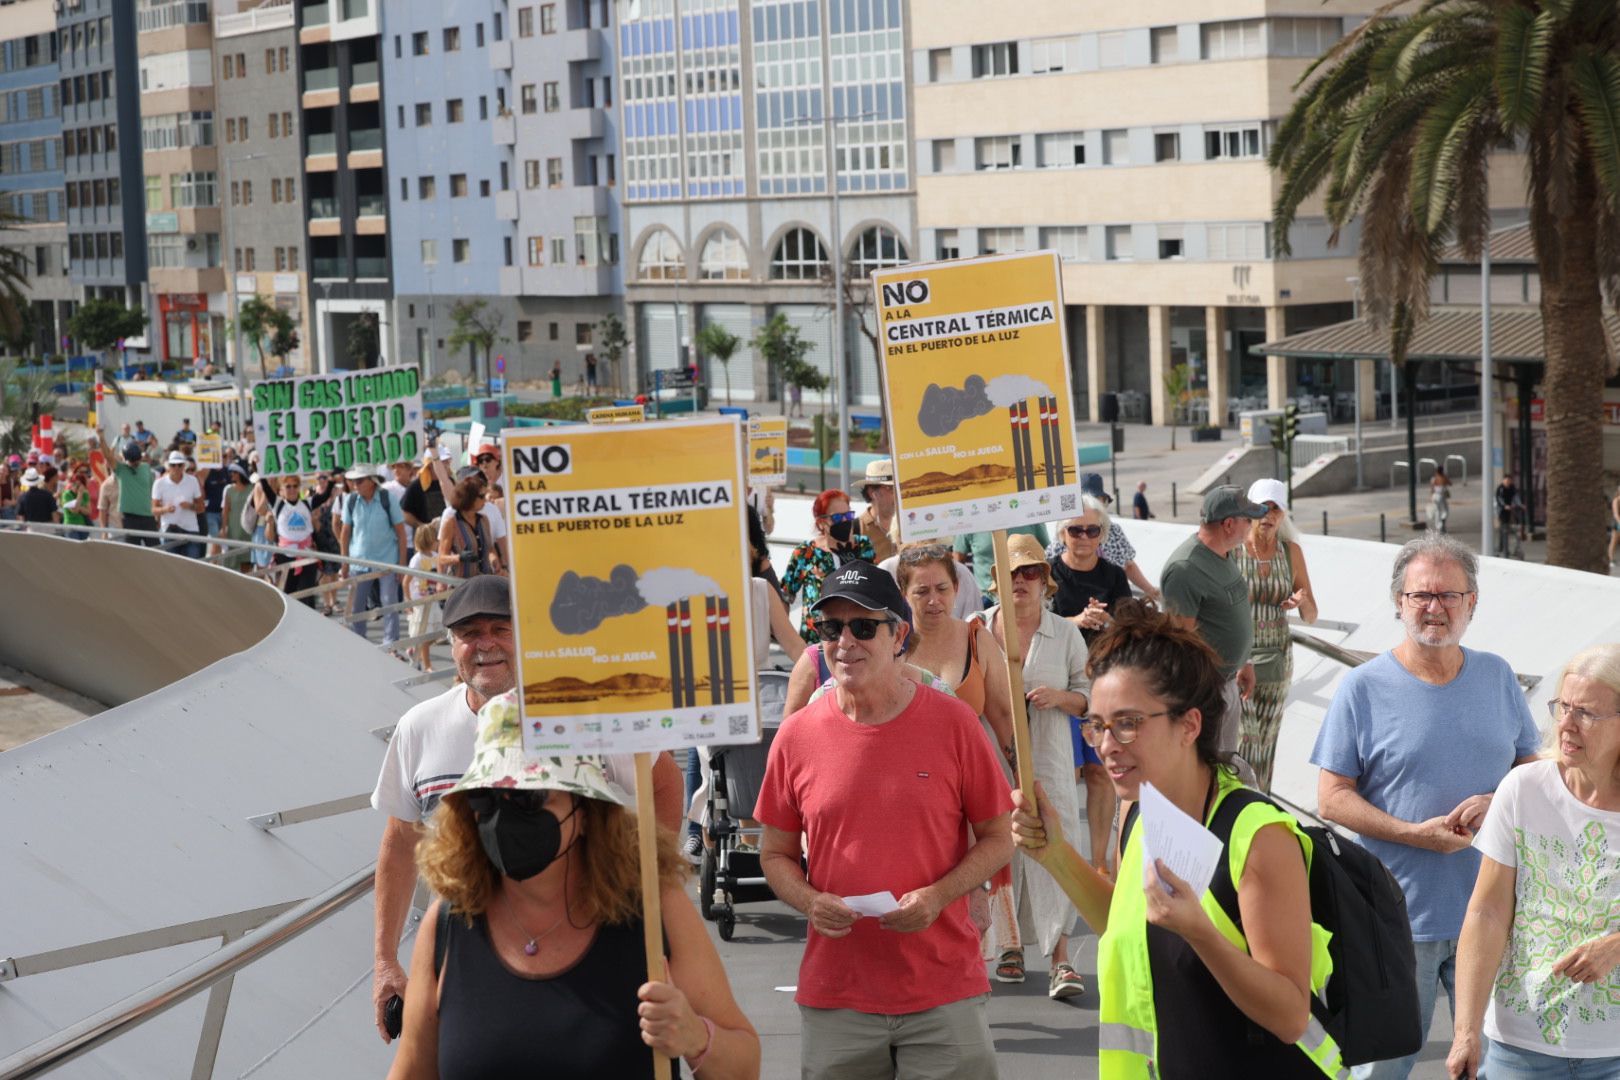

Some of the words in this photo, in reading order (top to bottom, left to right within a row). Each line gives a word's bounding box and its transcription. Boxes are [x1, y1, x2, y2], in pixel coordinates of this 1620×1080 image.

[882, 280, 928, 307] NO
[885, 311, 894, 320] A
[896, 309, 912, 319] LA
[887, 317, 971, 341] CENTRAL
[975, 306, 1053, 329] TÉRMICA
[888, 346, 903, 356] EN
[906, 344, 918, 354] EL
[921, 338, 963, 351] PUERTO
[965, 335, 979, 345] DE
[982, 333, 996, 343] LA
[998, 330, 1020, 340] LUZ
[253, 381, 294, 411] SIN
[298, 379, 342, 409] GAS
[269, 411, 300, 442] EL
[309, 404, 405, 441] PUERTO
[264, 431, 417, 475] ASEGURADO
[512, 446, 569, 474] NO
[900, 452, 914, 460] CON
[925, 445, 956, 456] SALUD
[953, 450, 966, 459] NO
[977, 445, 1003, 455] JUEGA
[514, 481, 524, 491] A
[528, 480, 547, 491] LA
[516, 494, 621, 517] CENTRAL
[629, 486, 730, 510] TÉRMICA
[516, 523, 535, 535] EN
[539, 522, 553, 533] EL
[557, 518, 611, 532] PUERTO
[614, 517, 631, 529] DE
[635, 516, 653, 527] LA
[657, 513, 684, 526] LUZ
[525, 651, 543, 659] CON
[558, 646, 596, 657] SALUD
[592, 654, 609, 664] NO
[611, 655, 622, 663] SE
[623, 651, 657, 663] JUEGA
